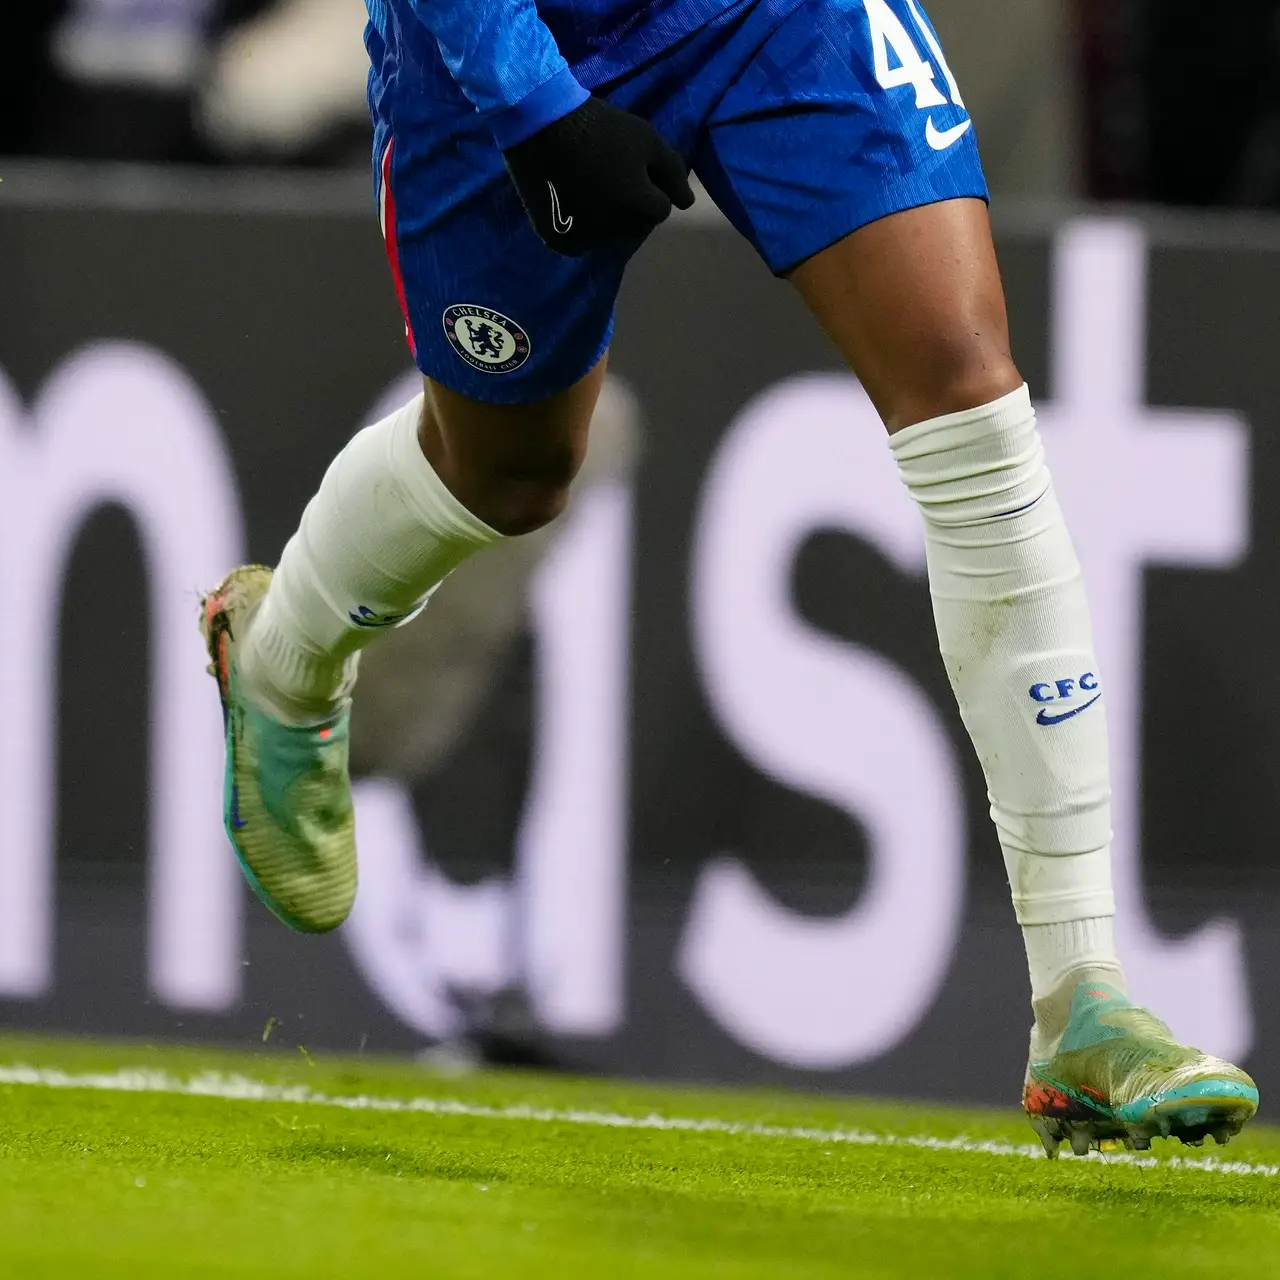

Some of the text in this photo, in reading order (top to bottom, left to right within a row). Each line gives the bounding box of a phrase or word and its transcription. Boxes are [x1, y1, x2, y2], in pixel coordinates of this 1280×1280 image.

[452, 307, 507, 327] CHELSEA
[460, 350, 518, 370] FOOTBALL CLUB
[1028, 672, 1099, 702] CFC
